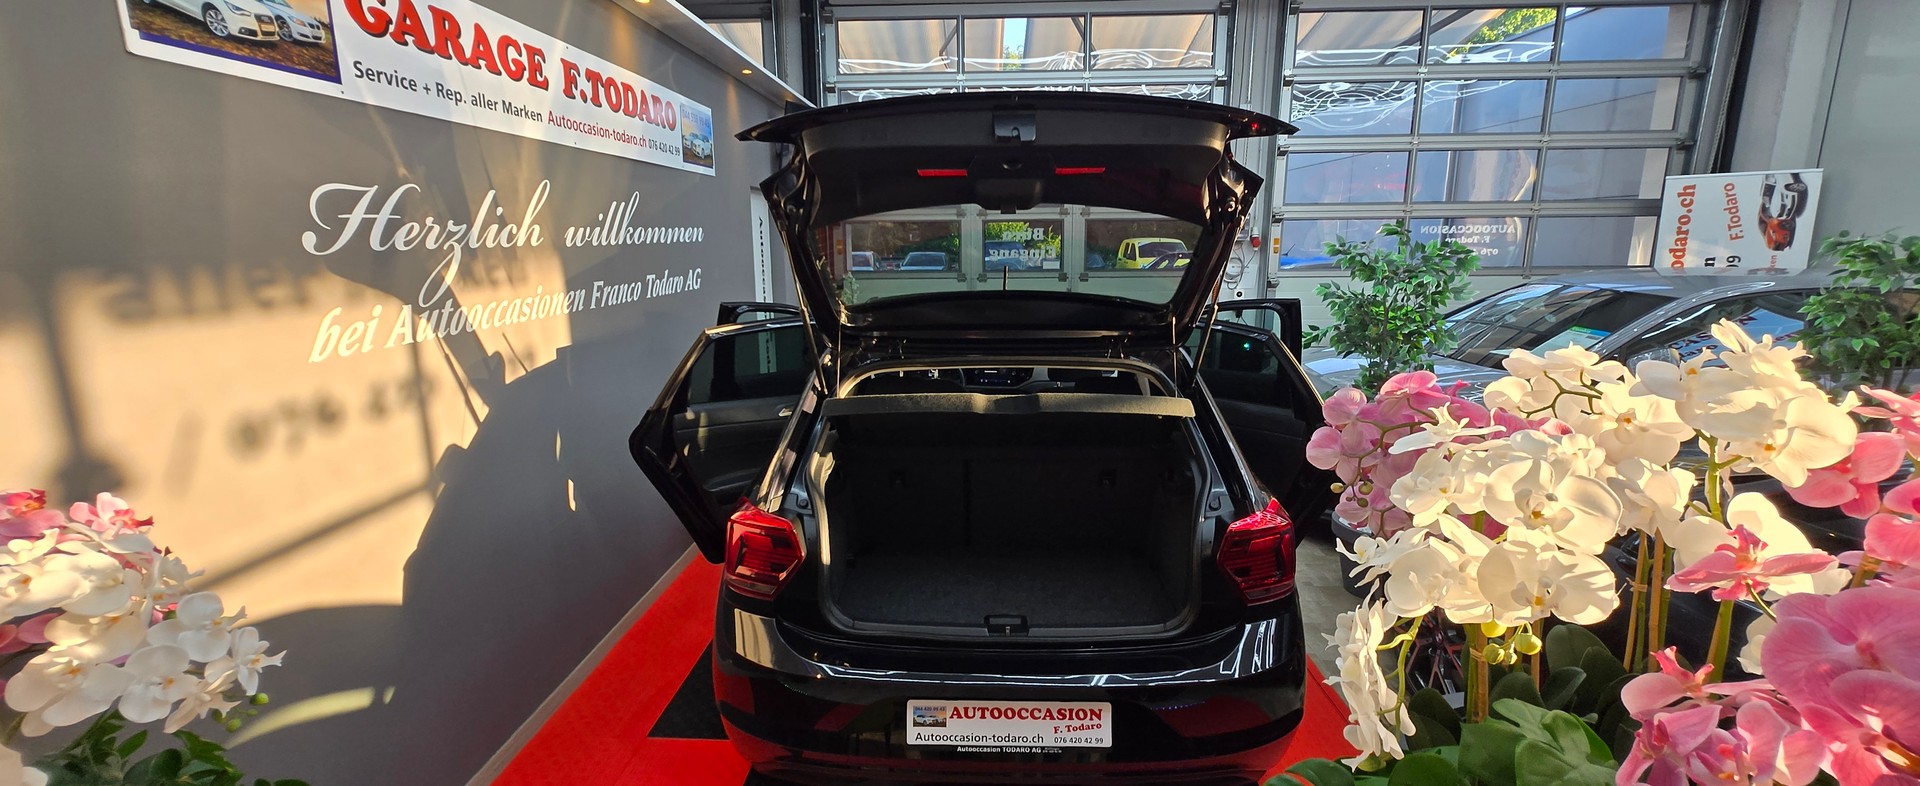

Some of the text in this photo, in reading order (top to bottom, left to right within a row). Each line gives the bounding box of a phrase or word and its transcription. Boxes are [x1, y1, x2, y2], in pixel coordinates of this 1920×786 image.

[343, 0, 677, 131] GARAGE F.TODARO
[353, 60, 680, 156] Service + Rep. aller Marken Autooccasion-todaro.ch 076 420 42 99
[302, 179, 550, 307] Herzlich
[564, 191, 704, 248] willkommen
[308, 267, 702, 364] bei Autooccasionen Franco Todaro AG
[915, 732, 1104, 745] Autooccasion-todaro.ch 076 420 42 99
[949, 706, 1103, 721] AUTOOCCASION
[1053, 723, 1102, 735] F. Todaro
